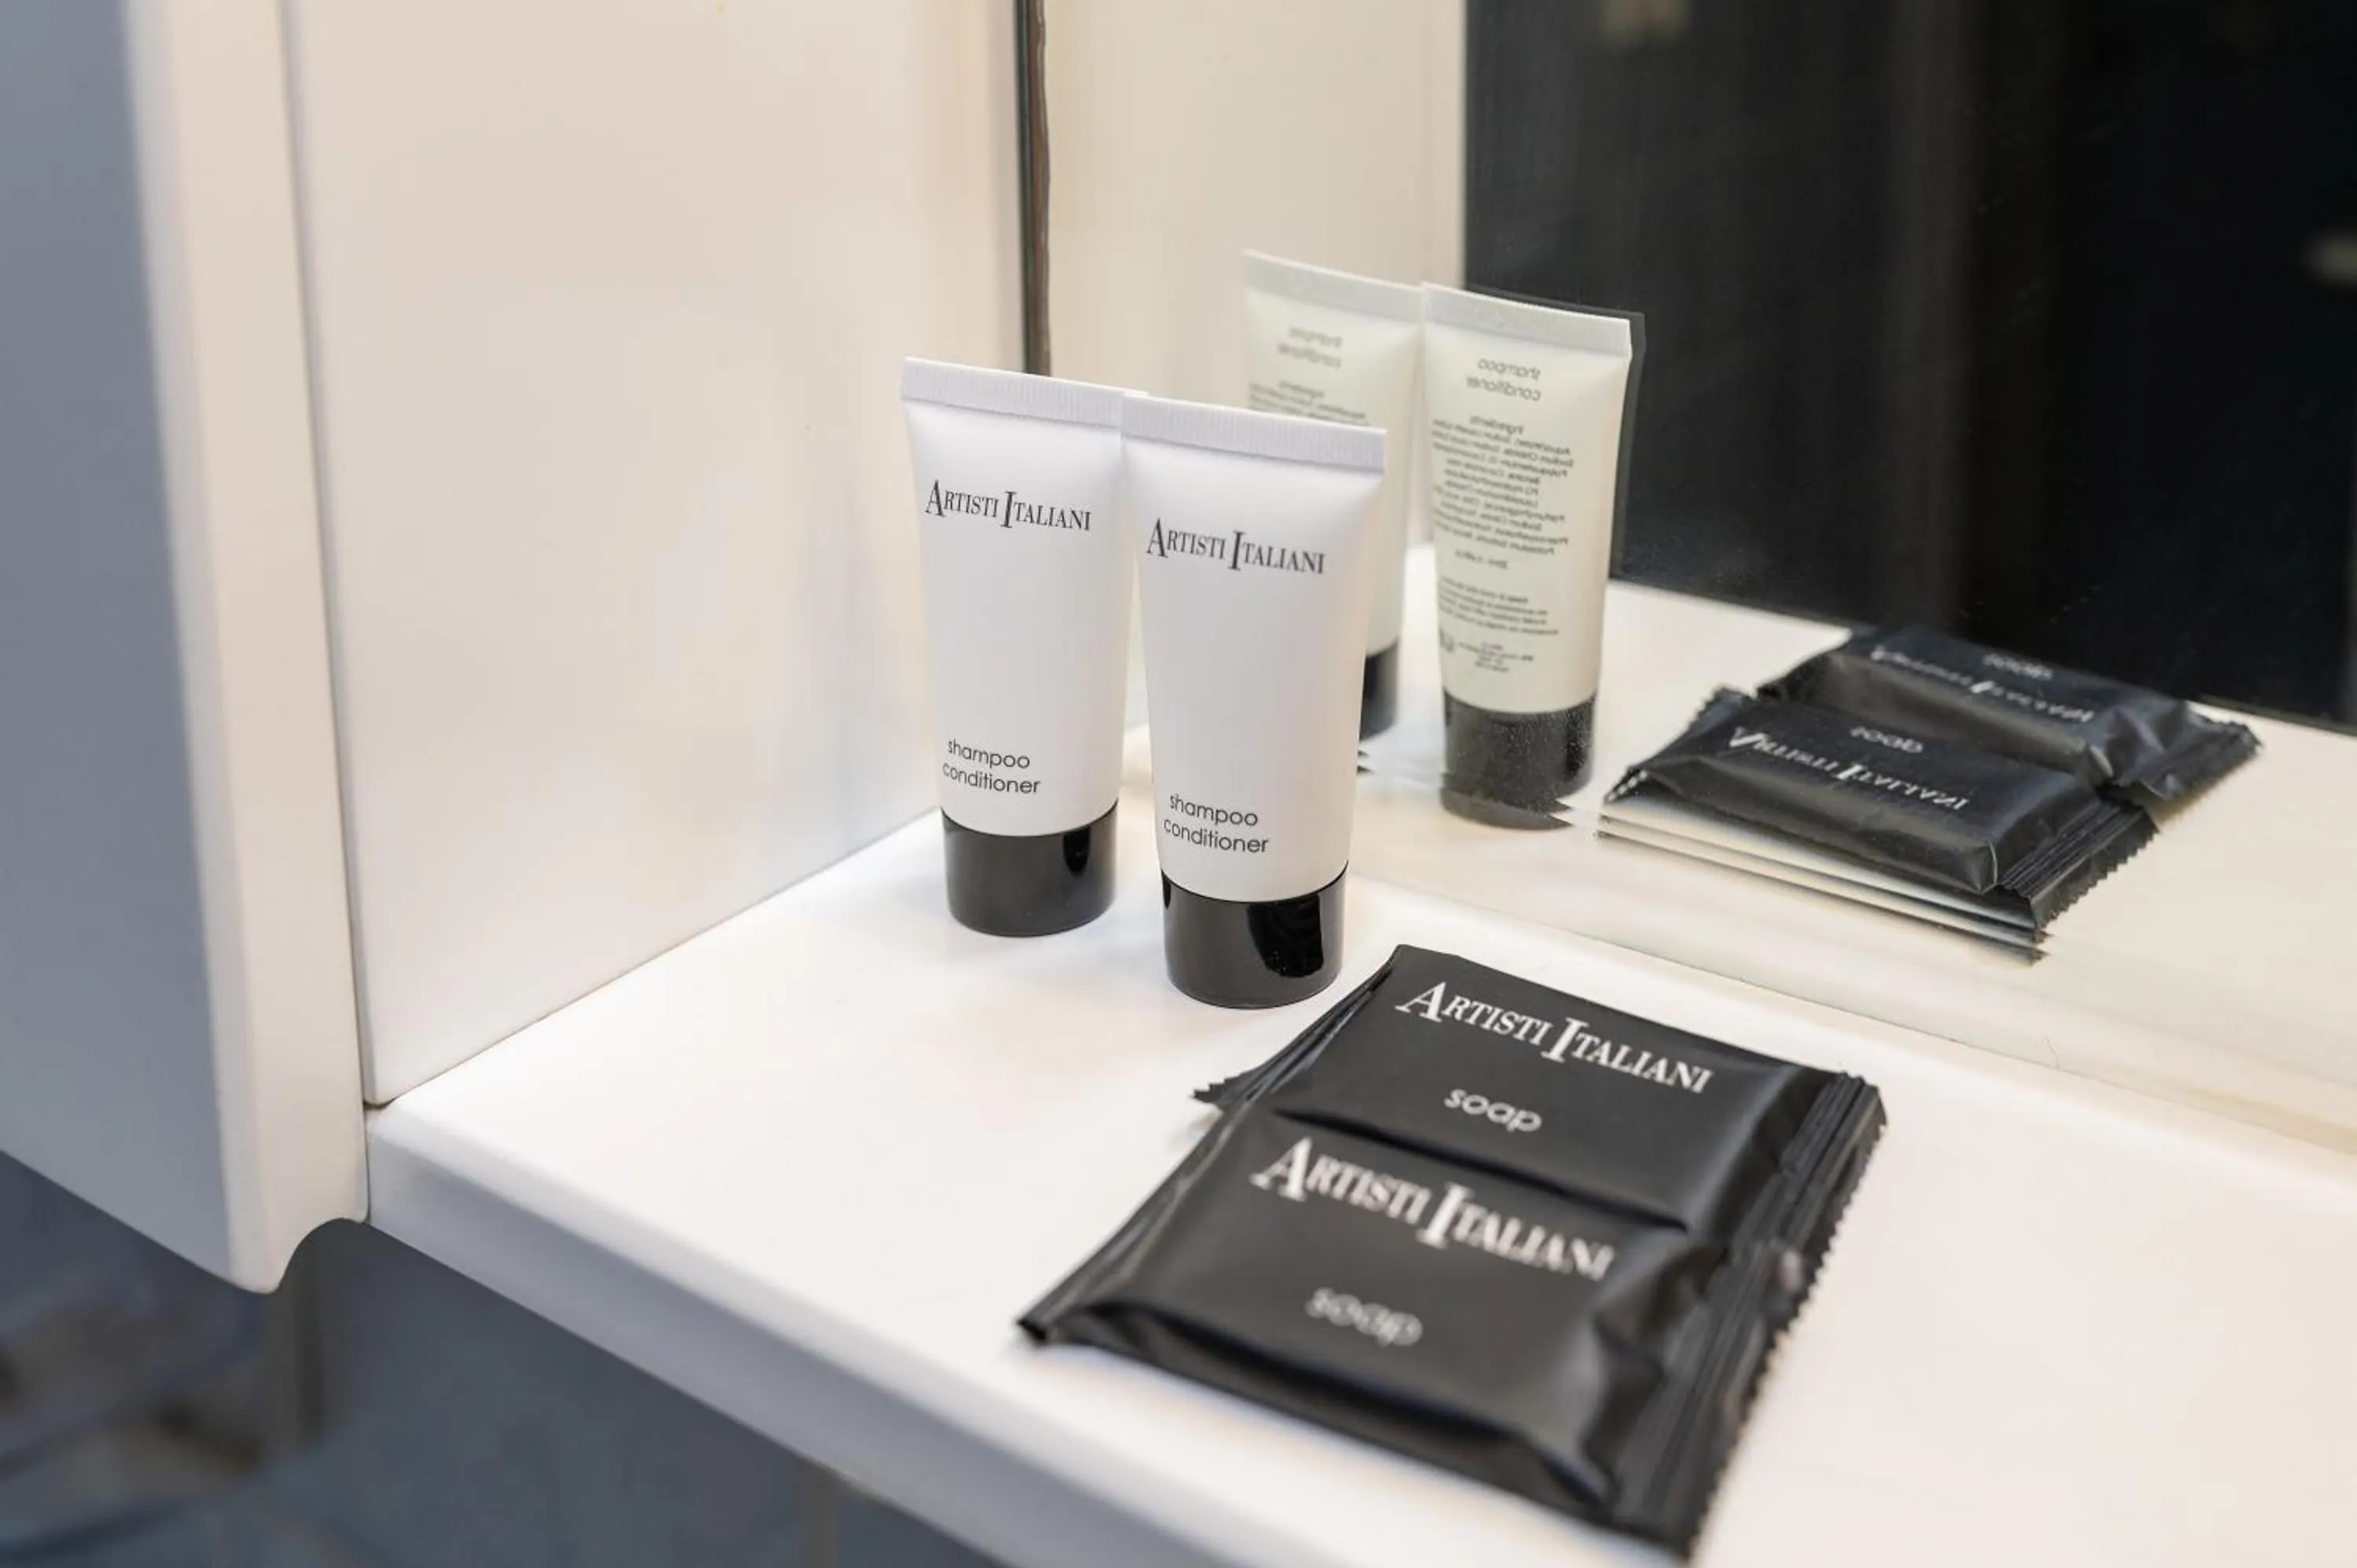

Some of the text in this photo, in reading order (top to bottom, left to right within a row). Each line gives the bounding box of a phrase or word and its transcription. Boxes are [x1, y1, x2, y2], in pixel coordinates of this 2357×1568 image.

[925, 479, 1091, 530] ARTISTI ITALIANI
[1146, 517, 1325, 574] ARTISTI ITALIANI
[943, 762, 1041, 793] conditioner
[948, 739, 1031, 769] shampoo
[1169, 793, 1258, 827] shampoo
[1164, 817, 1270, 853] conditioner
[1395, 981, 1715, 1094] ARTISTI ITALIANI
[1443, 1088, 1542, 1132] soap
[1250, 1137, 1615, 1281] ARTISTI ITALIANI
[1305, 1287, 1424, 1347] soap
